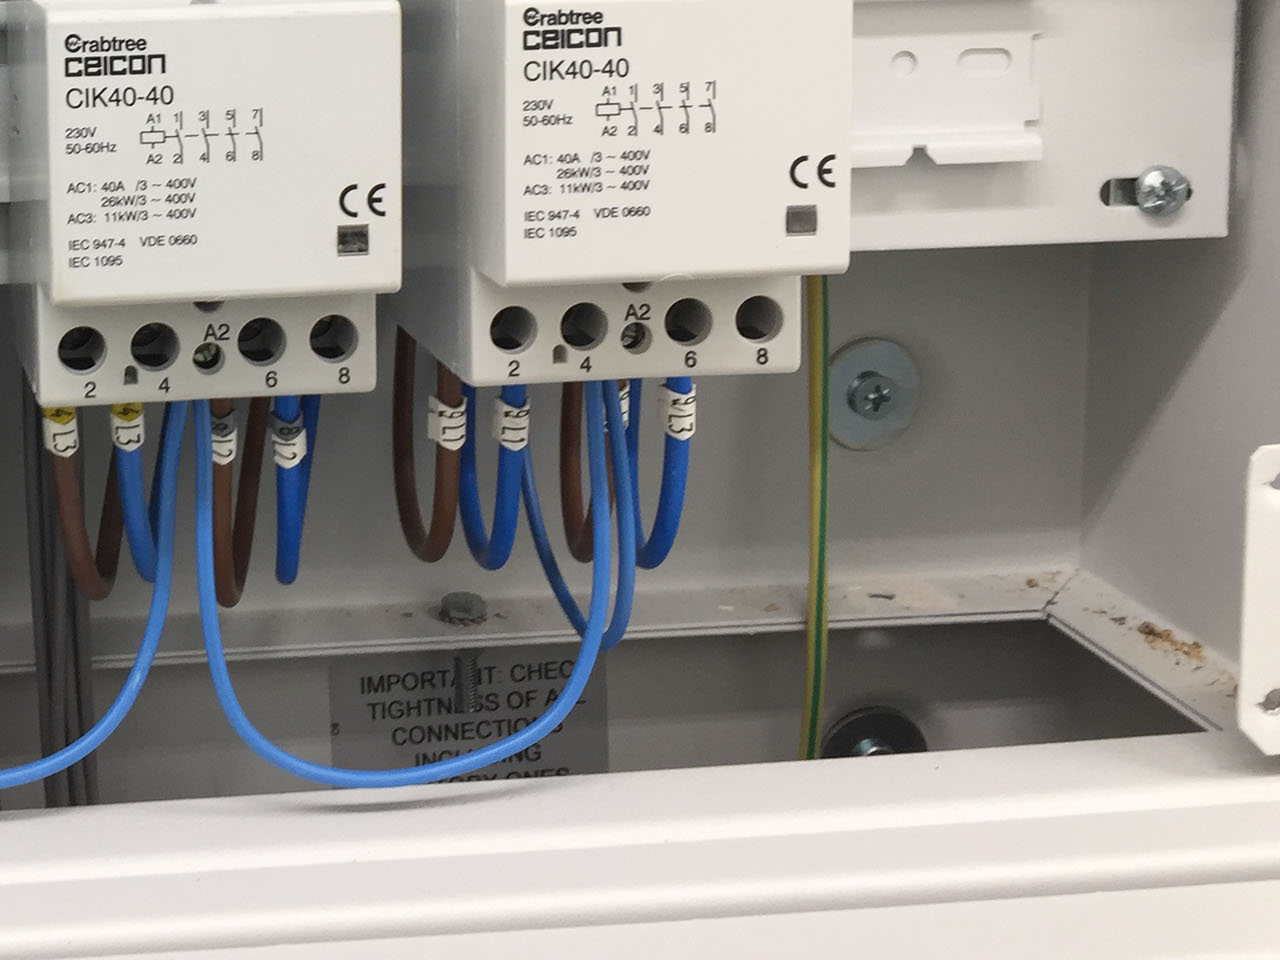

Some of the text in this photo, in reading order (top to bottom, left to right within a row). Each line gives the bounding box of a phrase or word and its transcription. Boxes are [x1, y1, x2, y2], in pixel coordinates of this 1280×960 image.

[523, 7, 603, 26] Crabtree
[65, 34, 147, 53] Crabtree
[524, 58, 629, 81] CIK40-40
[66, 85, 173, 109] CIK40-40
[523, 100, 553, 111] 230V
[523, 115, 572, 127] 50-60Hz
[65, 127, 96, 139] 230V
[66, 142, 117, 154] 50-60Hz
[523, 154, 552, 165] AC1:
[557, 153, 580, 164] 40A
[620, 150, 650, 161] 400V
[619, 165, 649, 176] 400V
[67, 182, 96, 193] AC1:
[101, 181, 125, 192] 40A
[166, 178, 197, 189] 400V
[523, 184, 551, 195] AC3:
[620, 180, 650, 191] 400V
[165, 193, 195, 204] 400V
[67, 213, 96, 224] AC3:
[166, 208, 196, 219] 400V
[524, 206, 650, 222] IEC 947-4 VDE 0660
[524, 226, 577, 239] IEC 1095
[69, 234, 197, 251] IEC 947-4 VDE 0660
[69, 255, 123, 268] IEC 1095
[625, 304, 650, 321] A2
[204, 324, 230, 341] A2
[508, 348, 768, 377] 2 4 6 8
[85, 367, 350, 398] 2 4 6 8
[360, 660, 575, 695] IMPORTT: CHEC
[507, 690, 537, 710] OF
